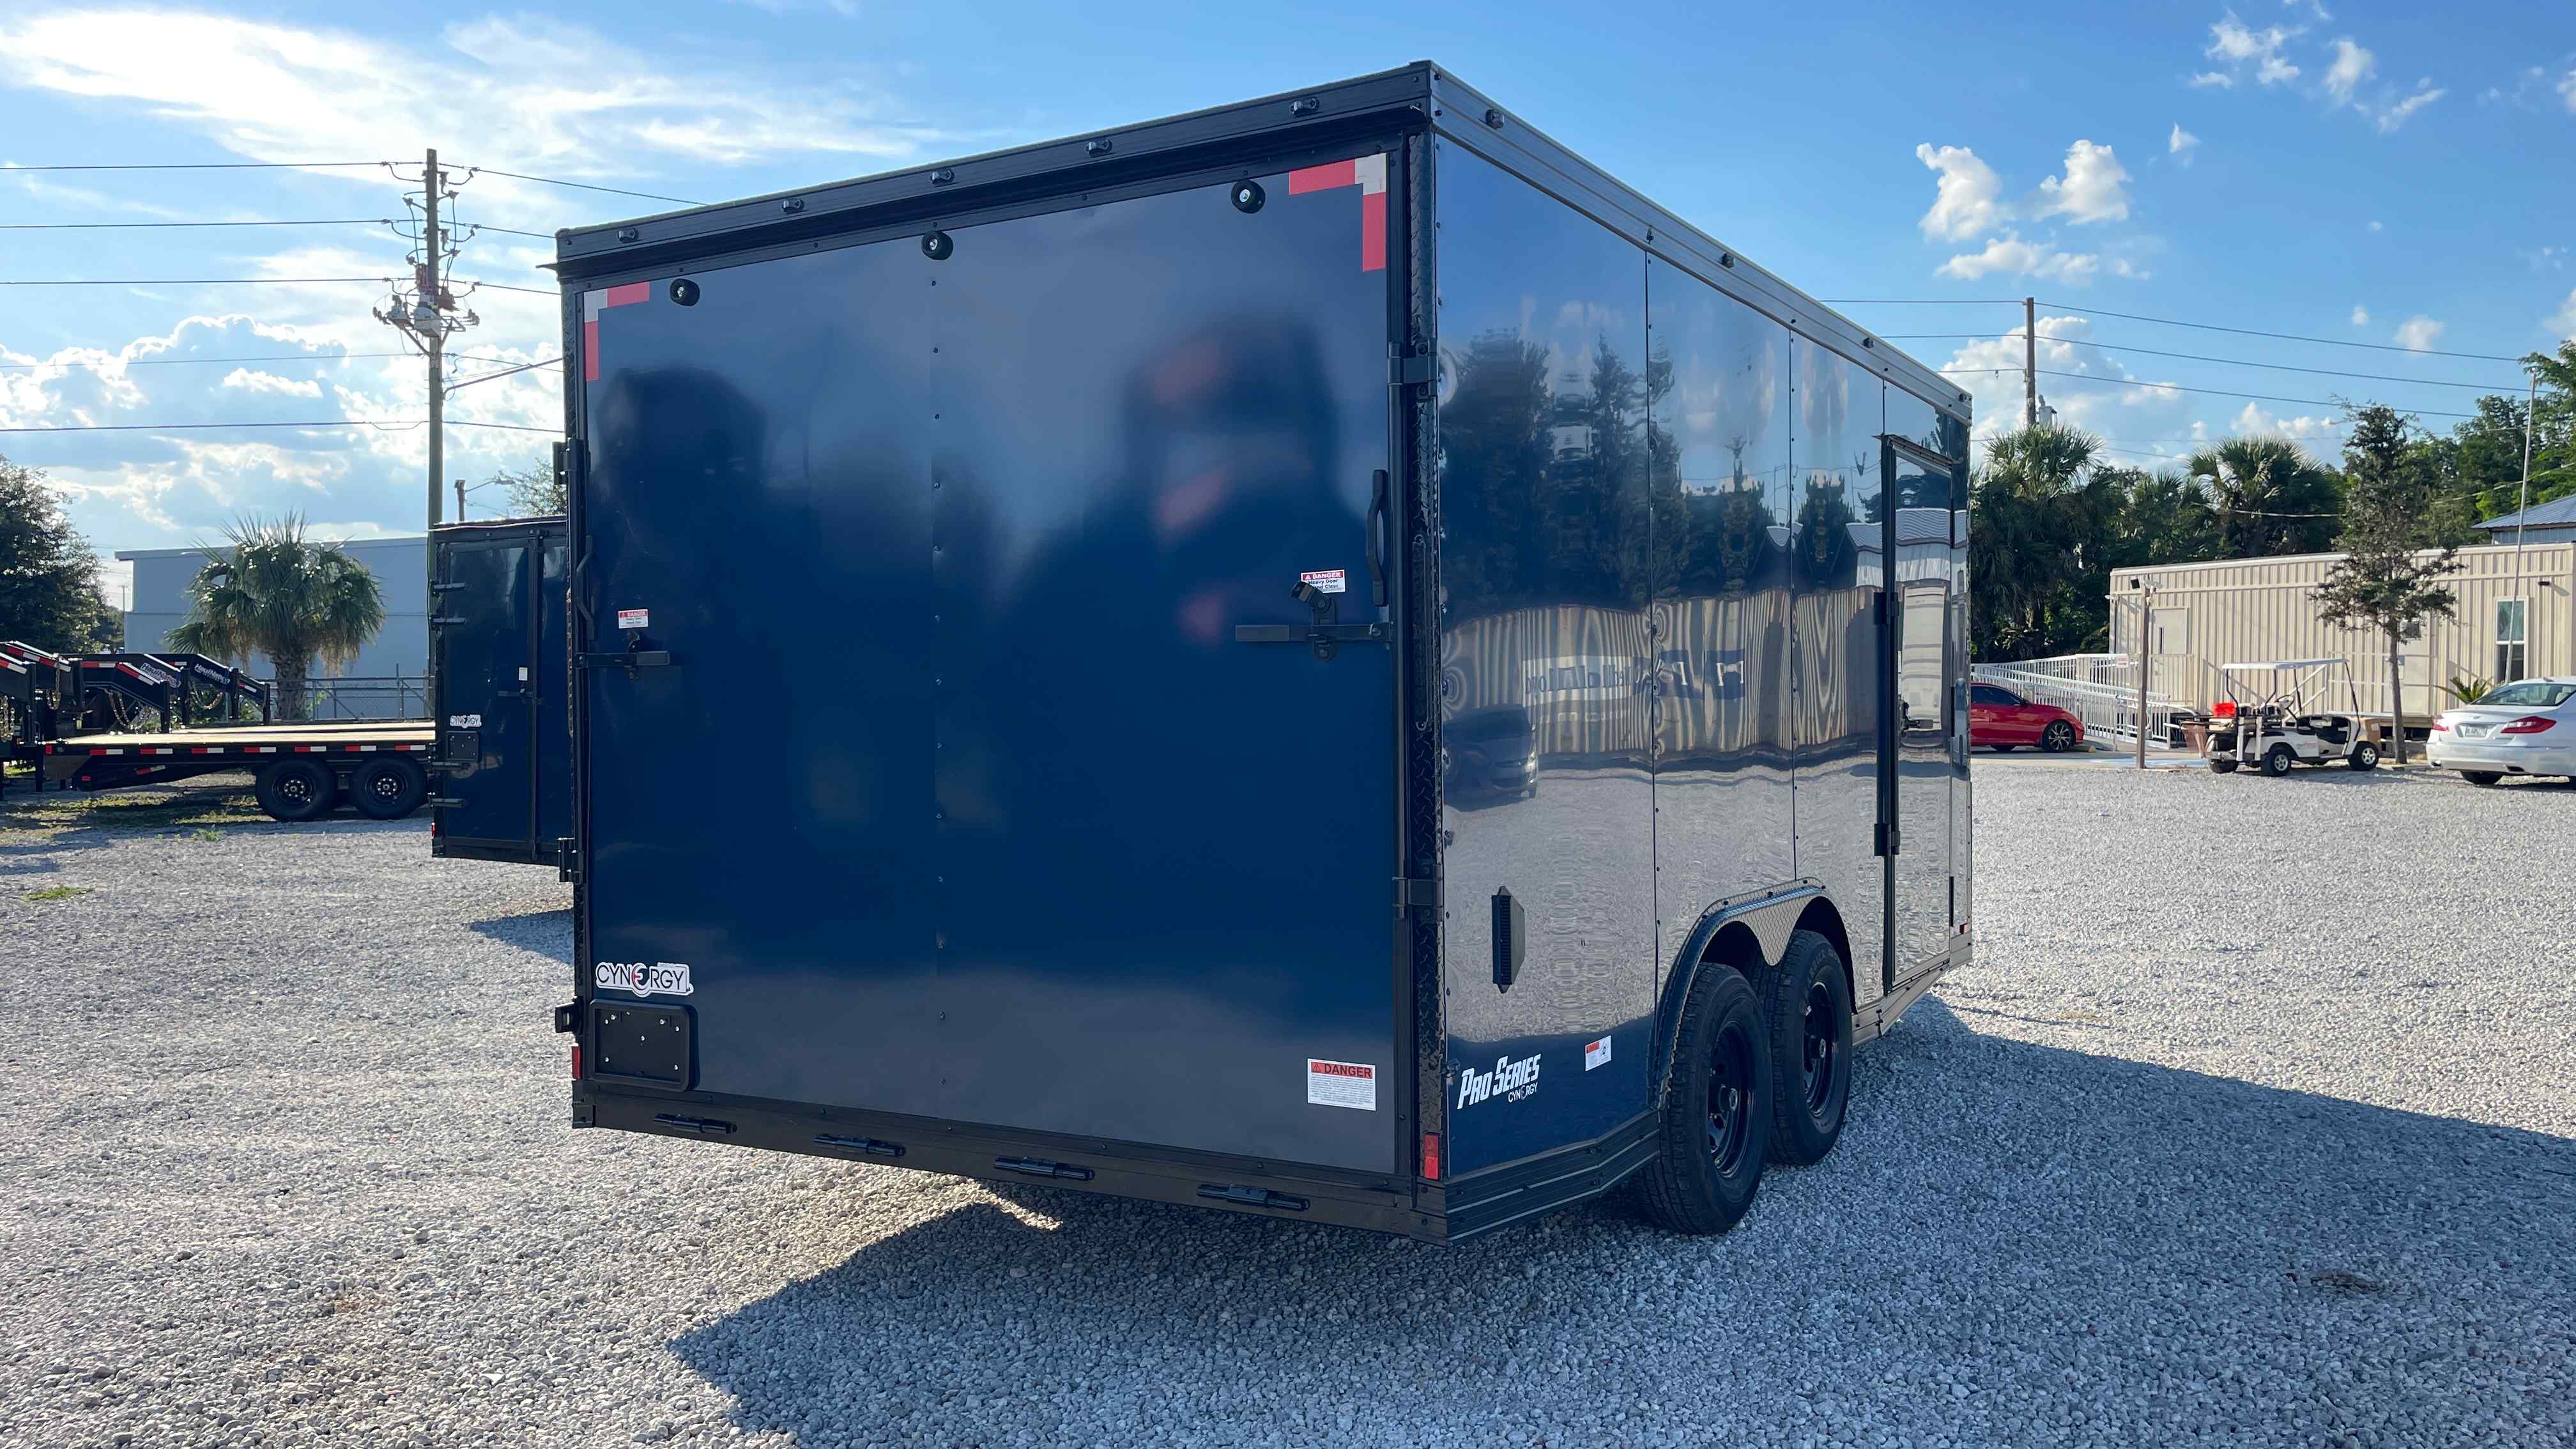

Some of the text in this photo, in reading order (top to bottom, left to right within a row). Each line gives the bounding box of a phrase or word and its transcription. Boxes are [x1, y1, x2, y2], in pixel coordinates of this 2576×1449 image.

[597, 964, 684, 990] CYNERGY
[1324, 1063, 1371, 1078] DANGER
[1508, 1082, 1538, 1103] CYNERGY
